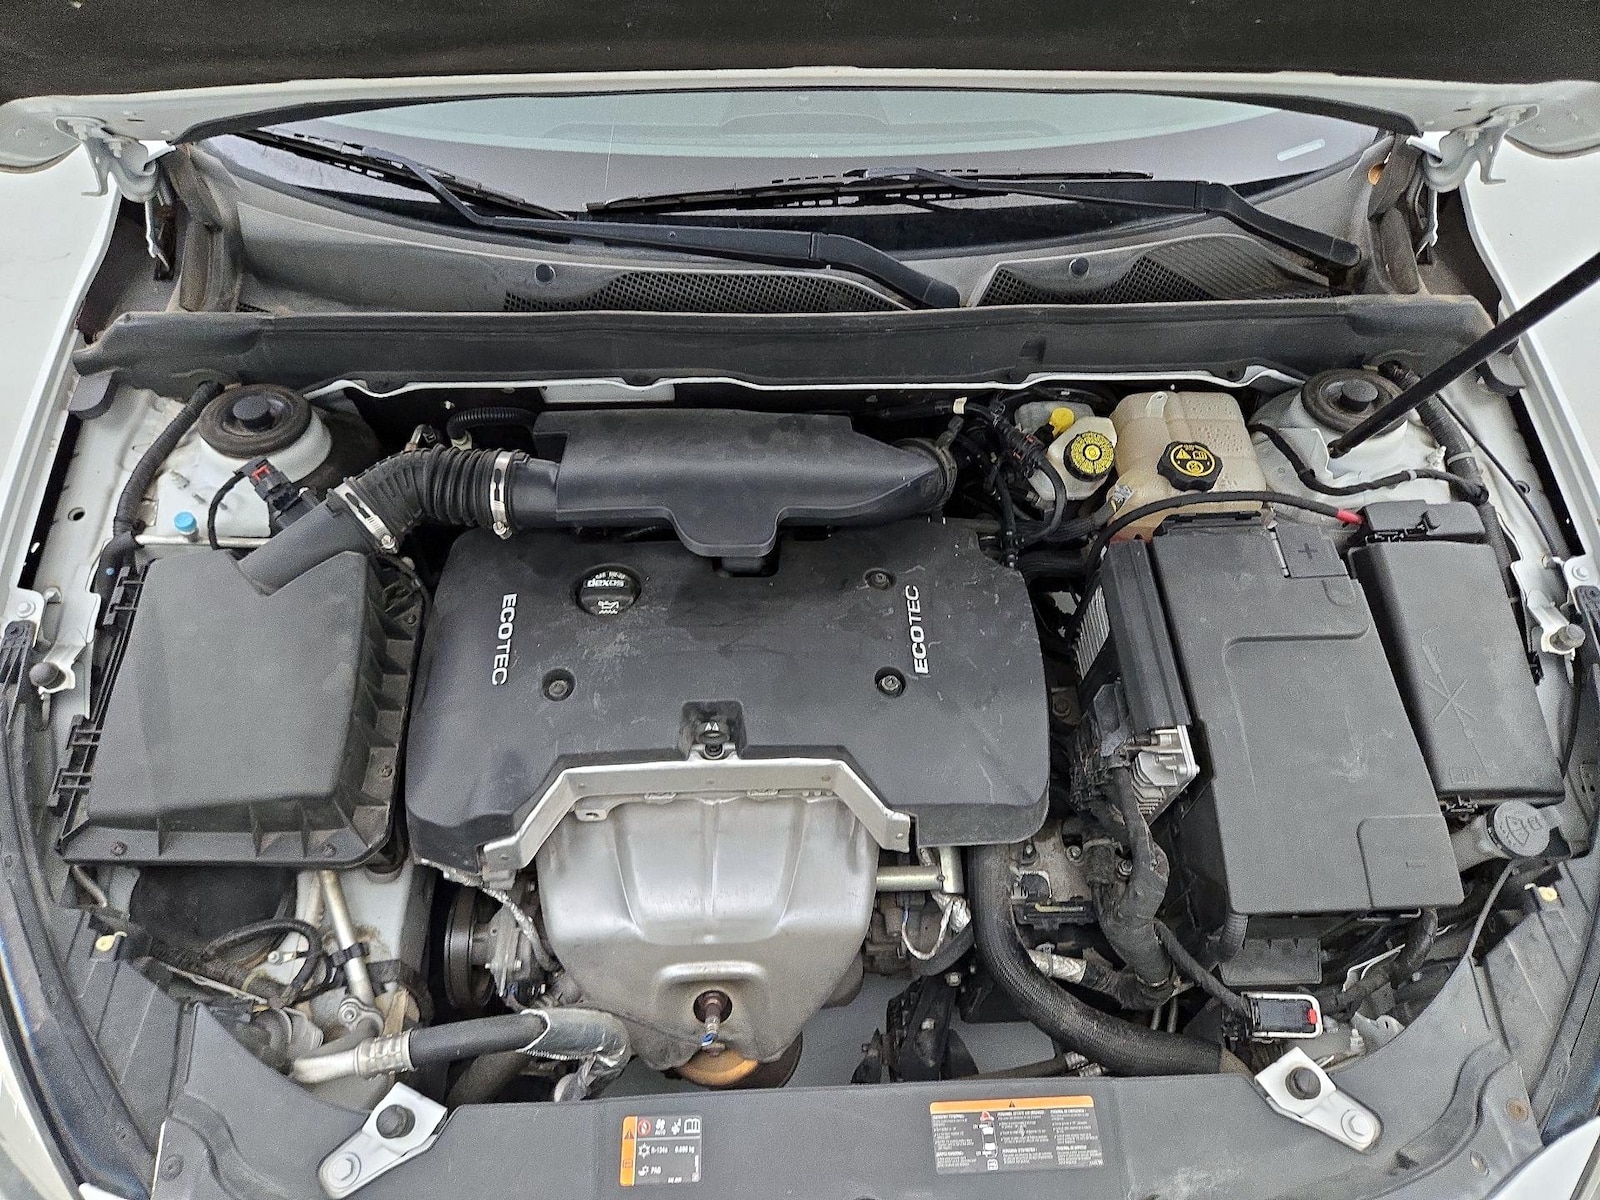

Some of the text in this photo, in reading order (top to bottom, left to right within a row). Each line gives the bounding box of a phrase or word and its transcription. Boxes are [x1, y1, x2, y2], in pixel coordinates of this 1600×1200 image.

[587, 578, 625, 587] dexos
[492, 593, 517, 686] ECOTEC
[904, 585, 929, 674] ECOTEC
